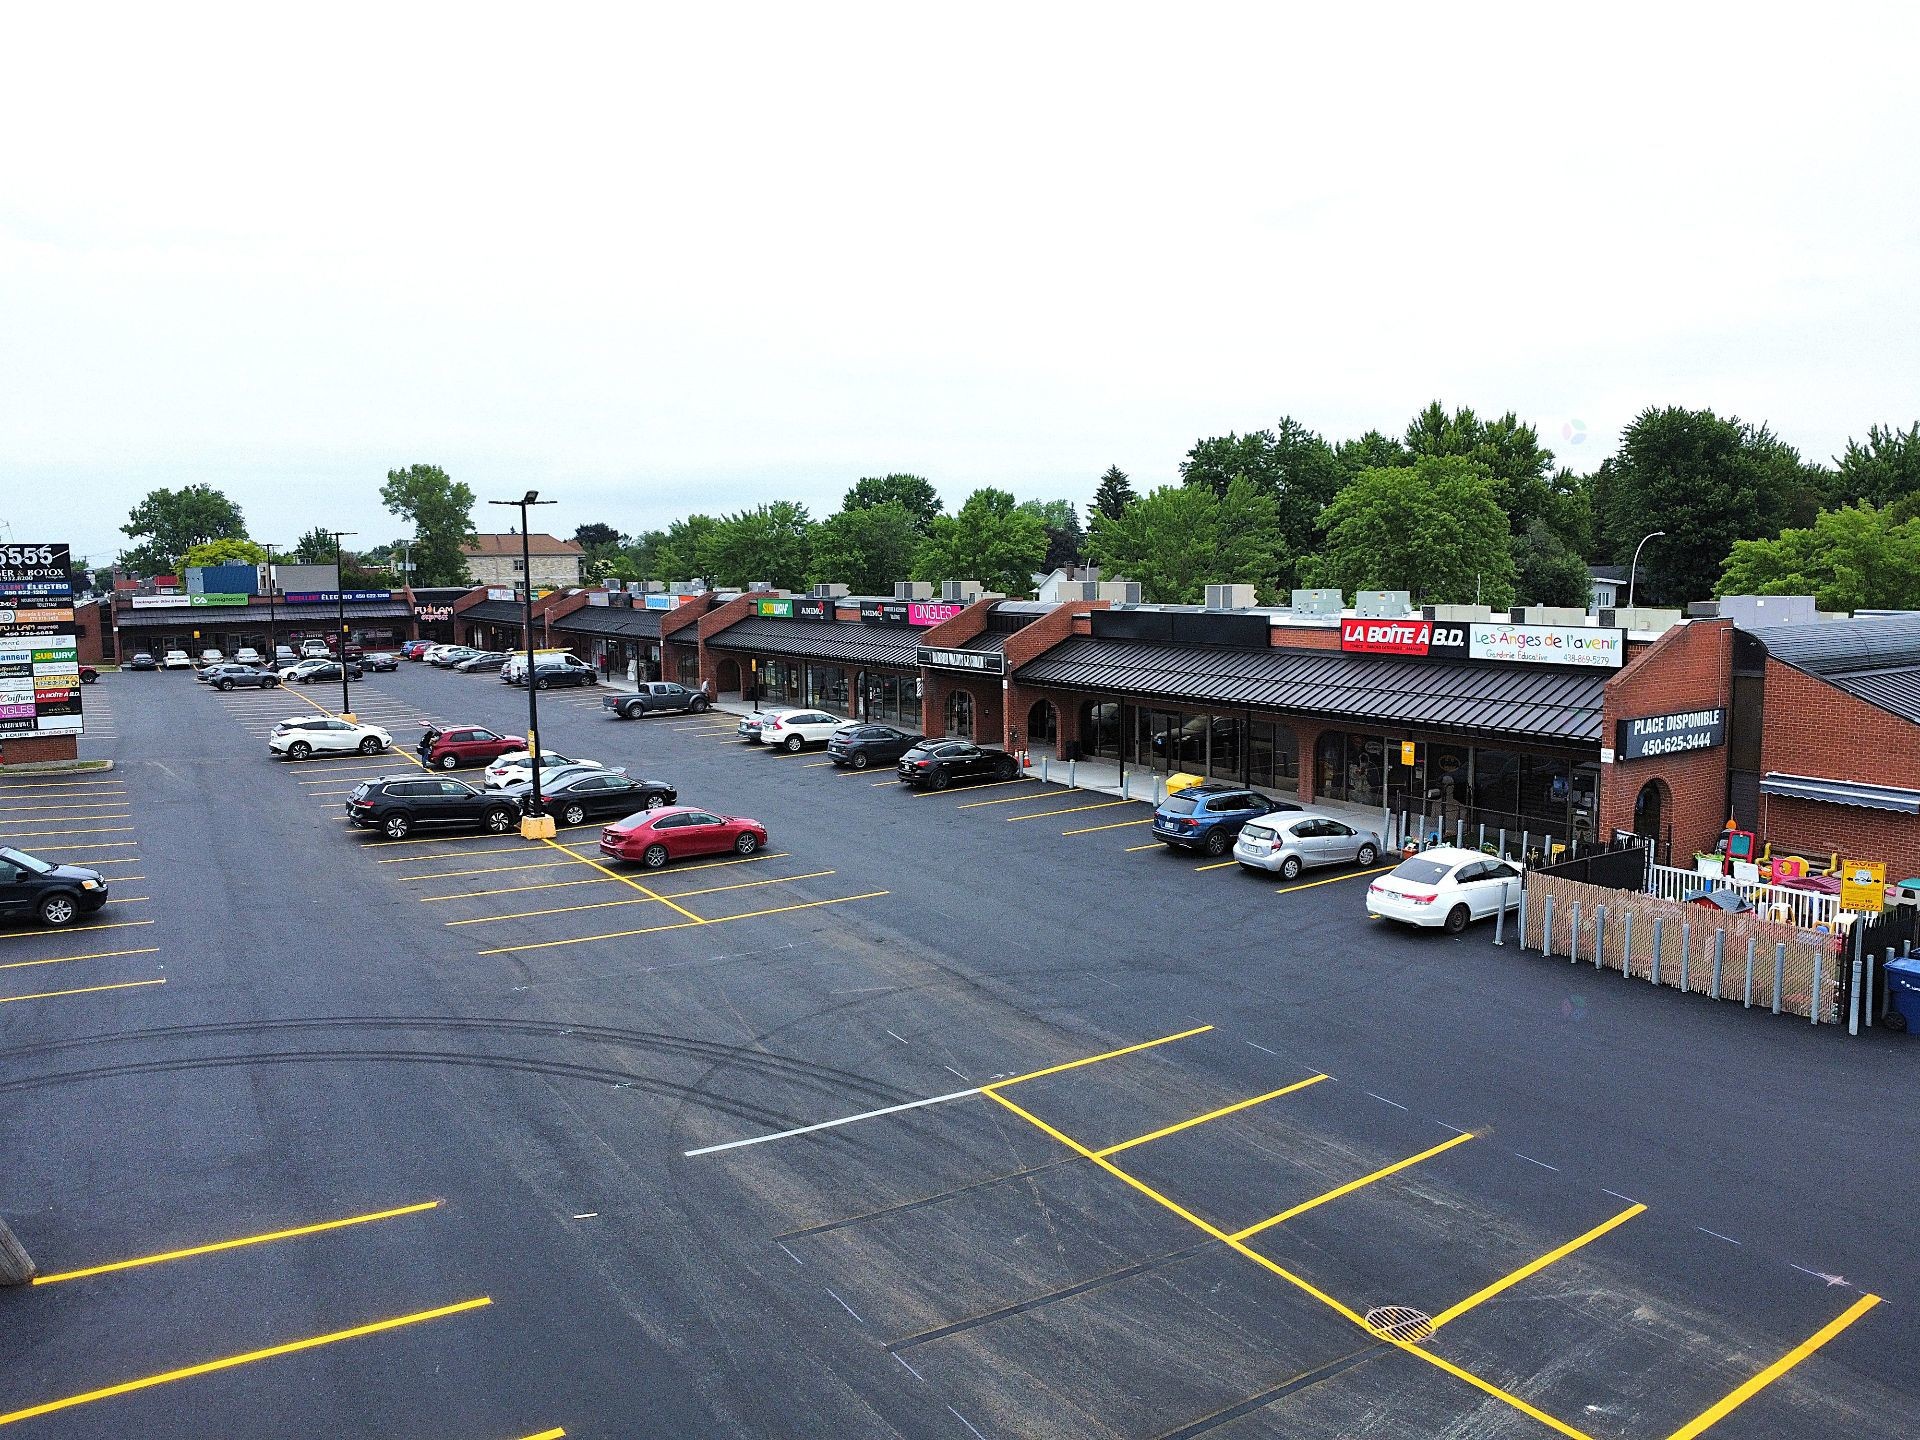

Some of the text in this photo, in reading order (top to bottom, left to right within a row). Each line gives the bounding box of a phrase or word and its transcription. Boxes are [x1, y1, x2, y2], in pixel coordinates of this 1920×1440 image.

[27, 568, 64, 576] BOTOX
[433, 606, 454, 615] LAM
[762, 603, 789, 614] SUBWAY
[914, 604, 952, 620] ONGLES
[1344, 625, 1365, 642] LA
[1366, 623, 1416, 645] BOÎTE
[1431, 628, 1465, 647] B.D.
[1474, 630, 1619, 650] Les Anges de l'avenir
[34, 652, 76, 660] SUBWAY
[1634, 710, 1719, 735] PLACE DISPONIBLE
[1642, 732, 1711, 755] 450-625-3444
